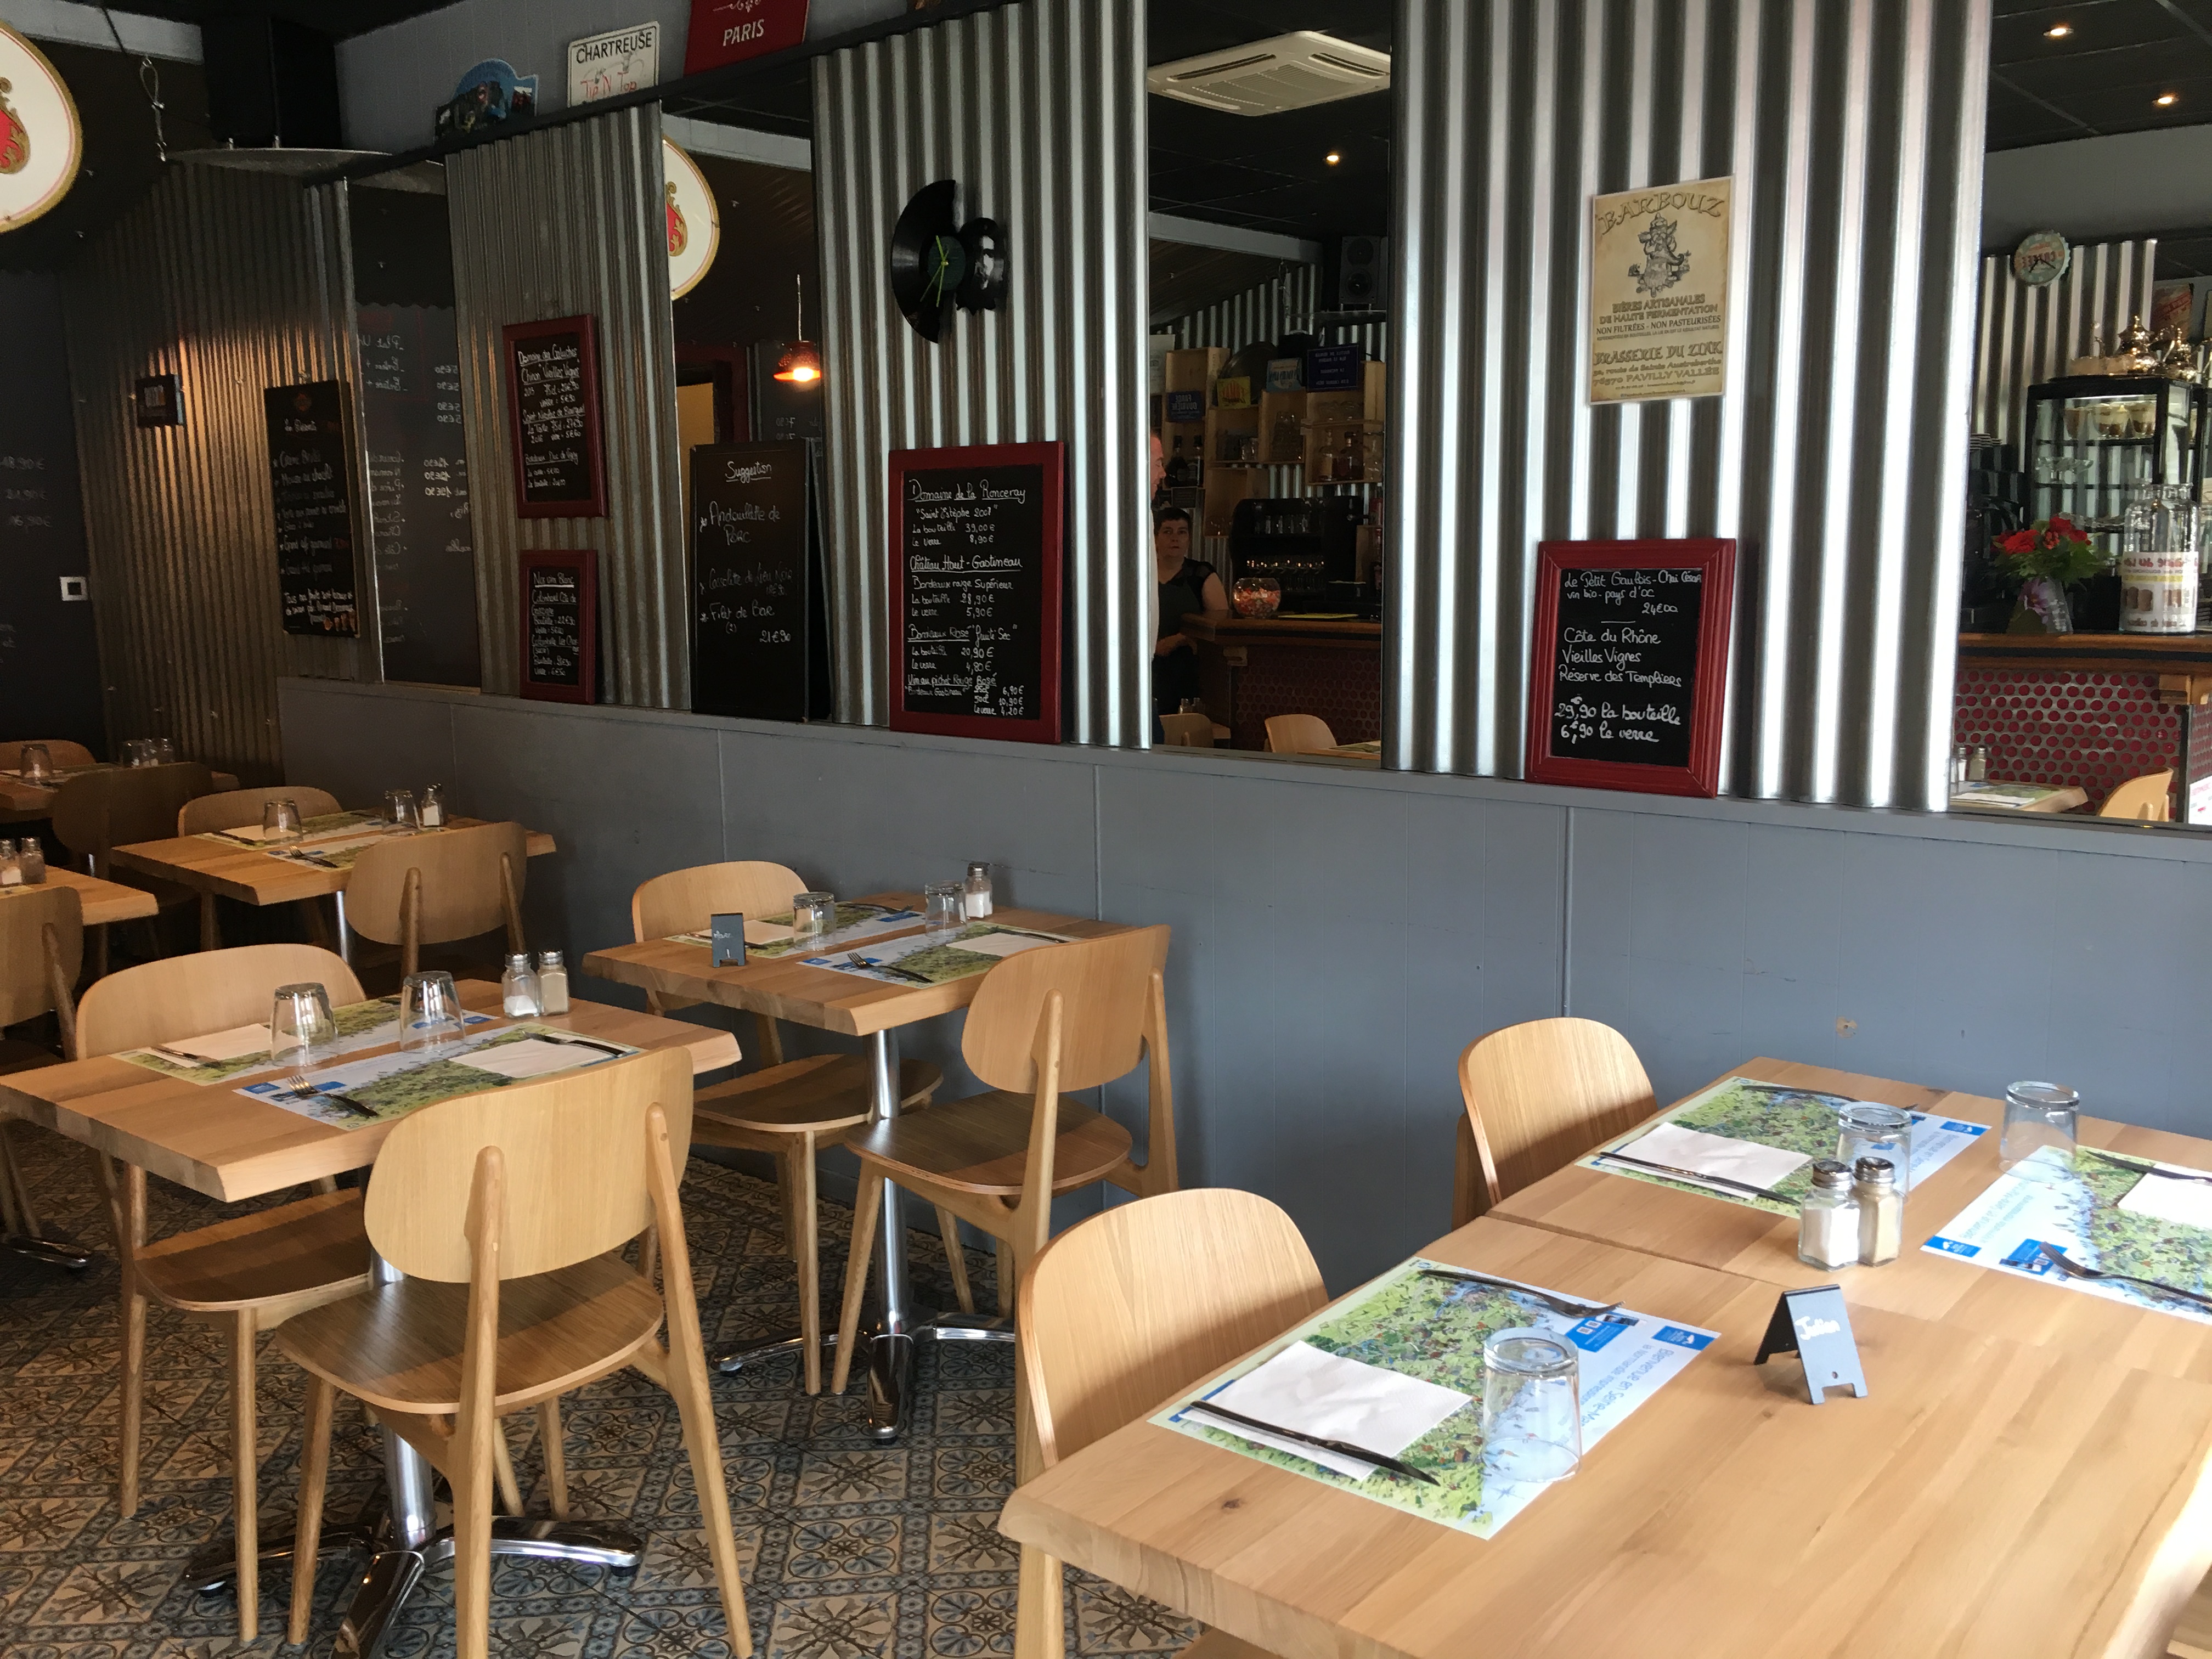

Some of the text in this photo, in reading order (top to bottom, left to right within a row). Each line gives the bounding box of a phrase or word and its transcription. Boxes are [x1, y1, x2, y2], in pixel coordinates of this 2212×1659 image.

[723, 19, 765, 47] PARIS
[576, 32, 652, 64] CHARTREUSE
[1598, 190, 1725, 236] BARBOUZ
[1643, 294, 1706, 310] ARTISANALES
[1596, 315, 1721, 335] NON FILTRÉES NON PASTEURISÉES
[1599, 304, 1718, 325] DE HAUTE FERMENTATION
[1594, 341, 1723, 365] BRASSERIE DU ZINK
[1626, 370, 1673, 382] PAVILLY
[907, 479, 952, 501] Domaine
[956, 483, 964, 499] de
[768, 505, 781, 523] de
[912, 575, 951, 590] Bordeaux
[1565, 573, 1578, 588] Le
[1580, 571, 1606, 588] Petit
[1611, 571, 1652, 587] Gaulois
[1566, 591, 1580, 600] vin
[1583, 589, 1597, 599] bio
[1605, 589, 1626, 606] pays
[736, 606, 748, 619] de
[1564, 627, 1662, 644] Côte du Rhône
[1561, 644, 1604, 664] Vieilles
[1558, 664, 1682, 688] Réserve des Templiers
[1601, 701, 1620, 719] la
[1622, 704, 1681, 725] bouteille
[1599, 720, 1615, 738] le
[1618, 729, 1660, 743] verre
[1627, 1347, 1675, 1381] Bienvenue
[1580, 1374, 1614, 1406] impression
[1580, 1390, 1624, 1427] Seine-Mar
